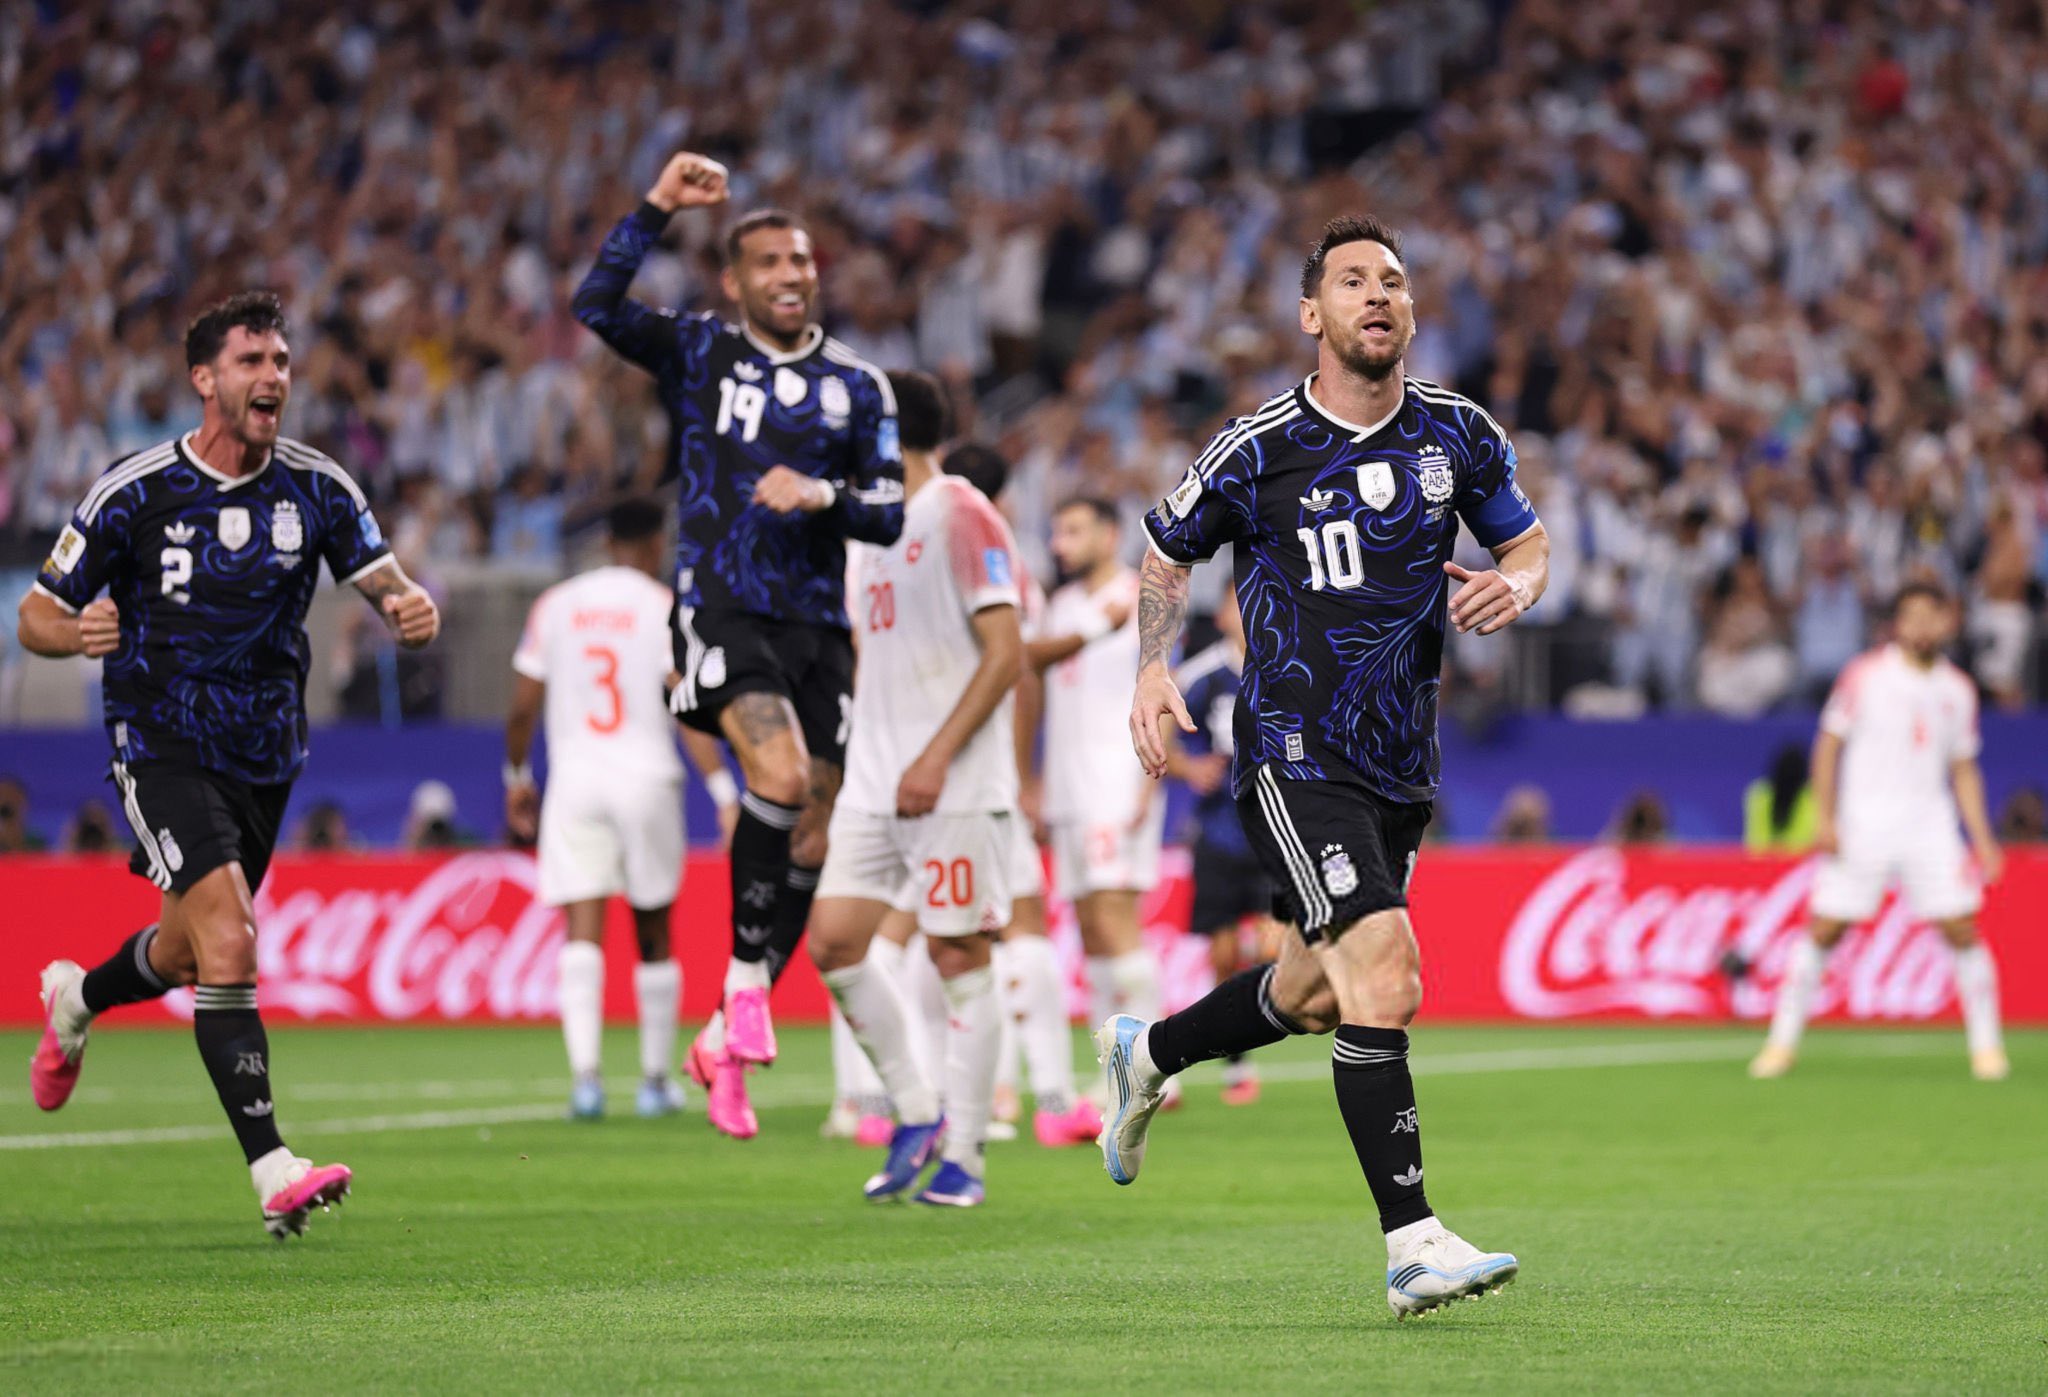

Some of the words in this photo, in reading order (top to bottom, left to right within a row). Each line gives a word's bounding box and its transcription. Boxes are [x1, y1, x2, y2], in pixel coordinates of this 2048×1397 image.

[715, 376, 767, 443] 19
[1428, 468, 1447, 488] AFA
[161, 547, 193, 606] 2
[1297, 519, 1365, 591] 10
[868, 579, 896, 634] 20
[584, 645, 624, 737] 3
[923, 855, 975, 908] 20
[164, 849, 570, 1020] ca-Cola
